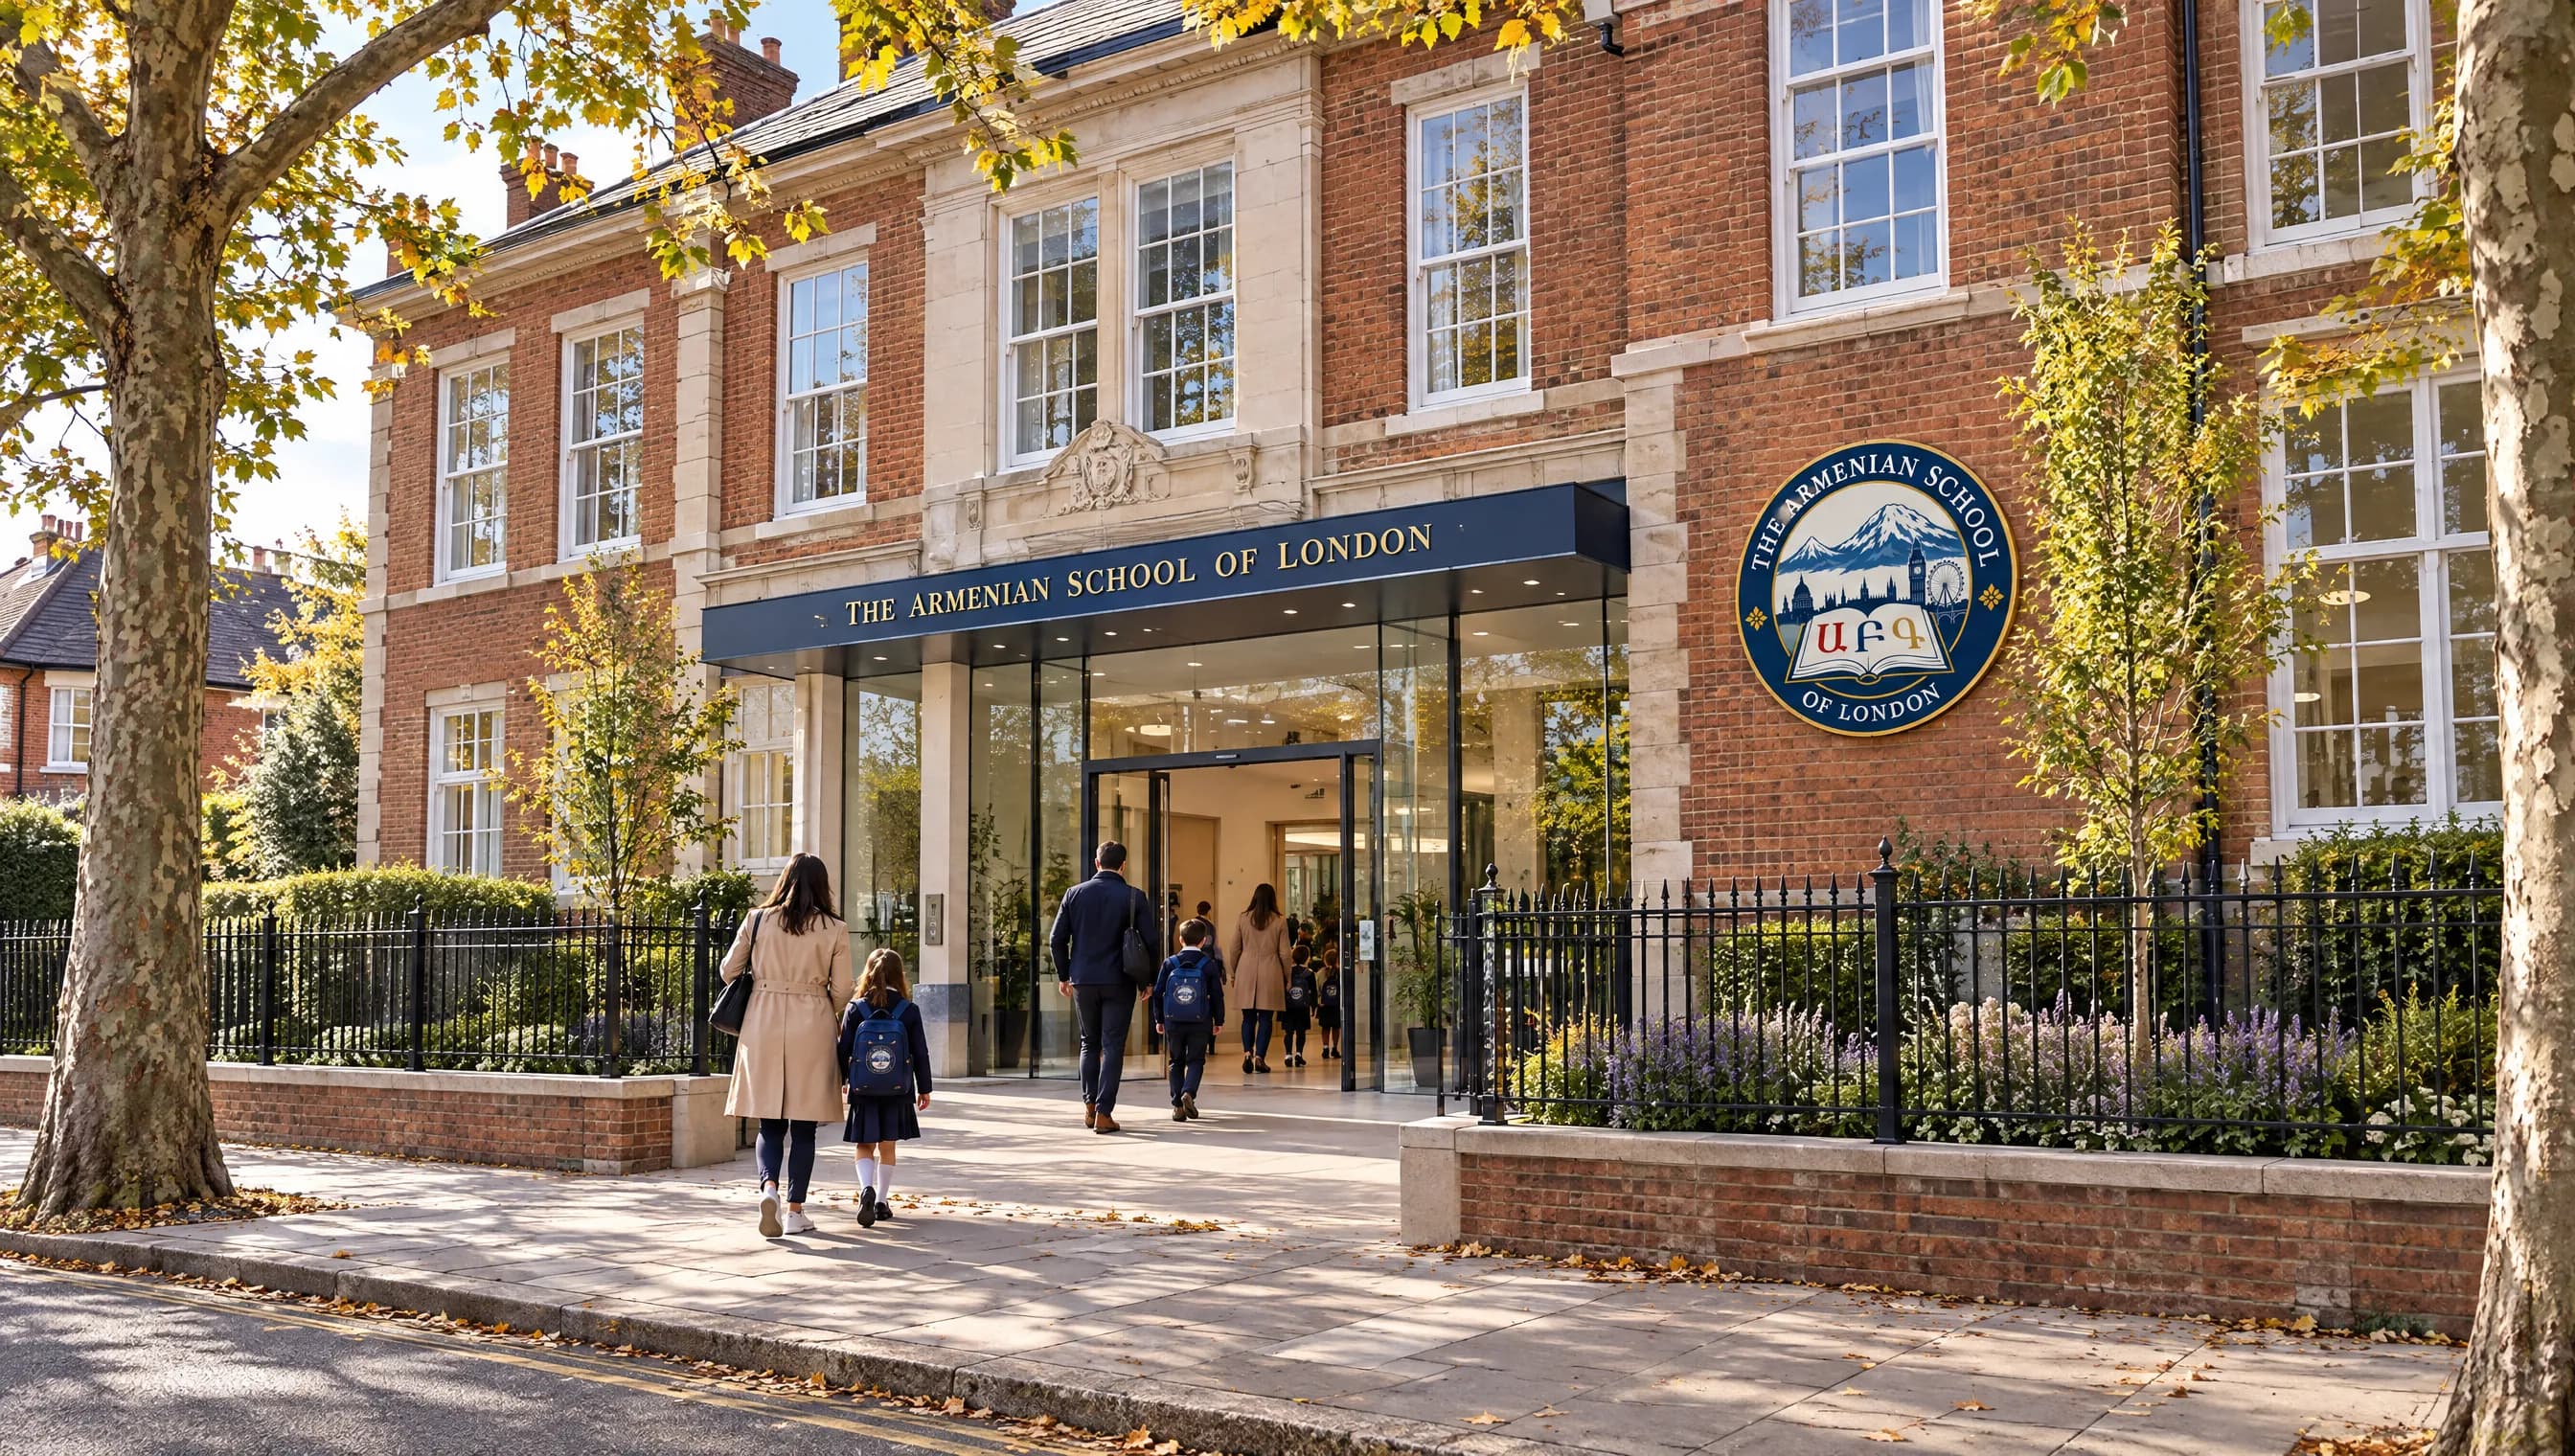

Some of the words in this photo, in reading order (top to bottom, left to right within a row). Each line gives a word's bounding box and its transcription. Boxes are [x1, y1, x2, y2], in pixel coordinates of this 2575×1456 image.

[1751, 517, 1786, 571] THE
[1785, 454, 1920, 518] ARMENIAN
[1924, 466, 2000, 568] SCHOOL
[846, 599, 896, 626] THE
[908, 577, 1051, 618] ARMENIAN
[1067, 557, 1196, 598] SCHOOL
[1215, 548, 1258, 578] OF
[1277, 523, 1432, 570] LONDON
[1802, 691, 1833, 714] OF
[1838, 683, 1941, 722] LONDON
